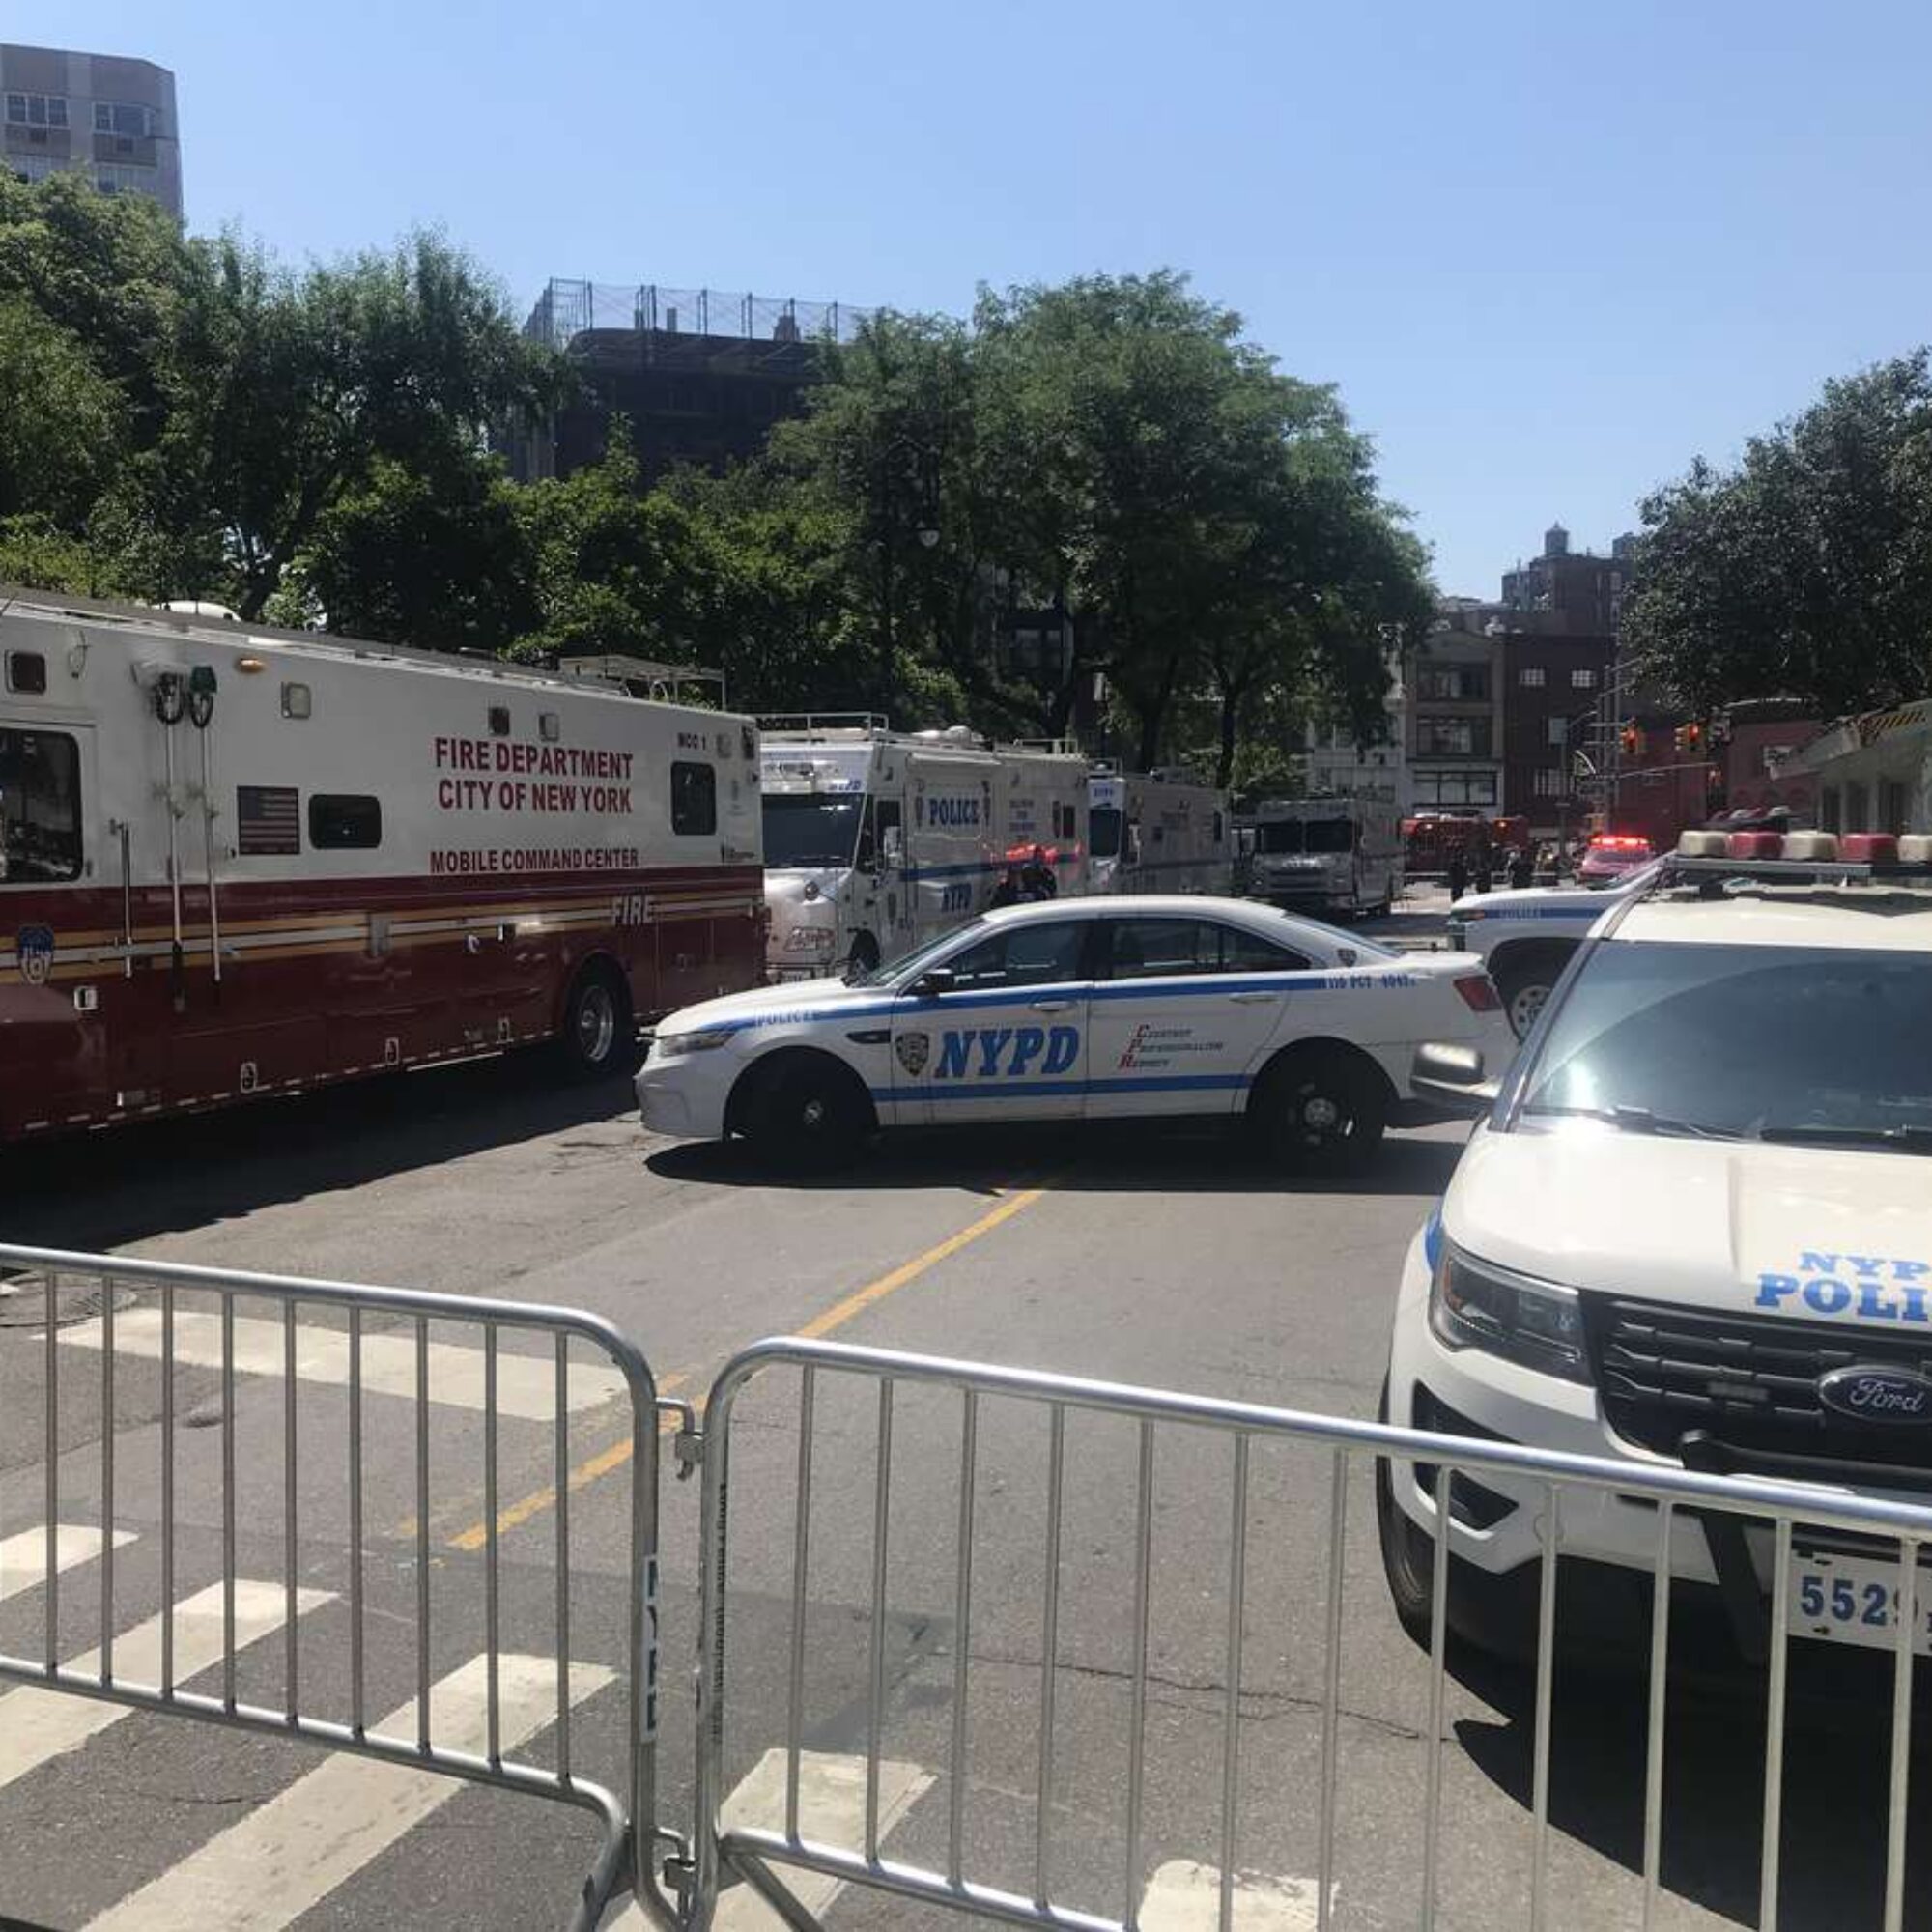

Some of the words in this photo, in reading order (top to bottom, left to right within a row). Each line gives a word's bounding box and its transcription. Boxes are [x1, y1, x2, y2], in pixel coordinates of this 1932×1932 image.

[435, 737, 490, 770] FIRE
[496, 742, 633, 780] DEPARTMENT
[439, 779, 493, 810] CITY
[498, 781, 526, 810] OF
[532, 783, 577, 811] NEW
[580, 785, 633, 813] YORK
[928, 797, 980, 827] POLICE
[430, 849, 498, 873] MOBILE
[502, 848, 582, 870] COMMAND
[585, 847, 639, 868] CENTER
[612, 892, 655, 927] FIRE
[756, 1009, 813, 1027] POLICE
[933, 1026, 1080, 1079] NYPD
[1849, 1378, 1927, 1414] Ford
